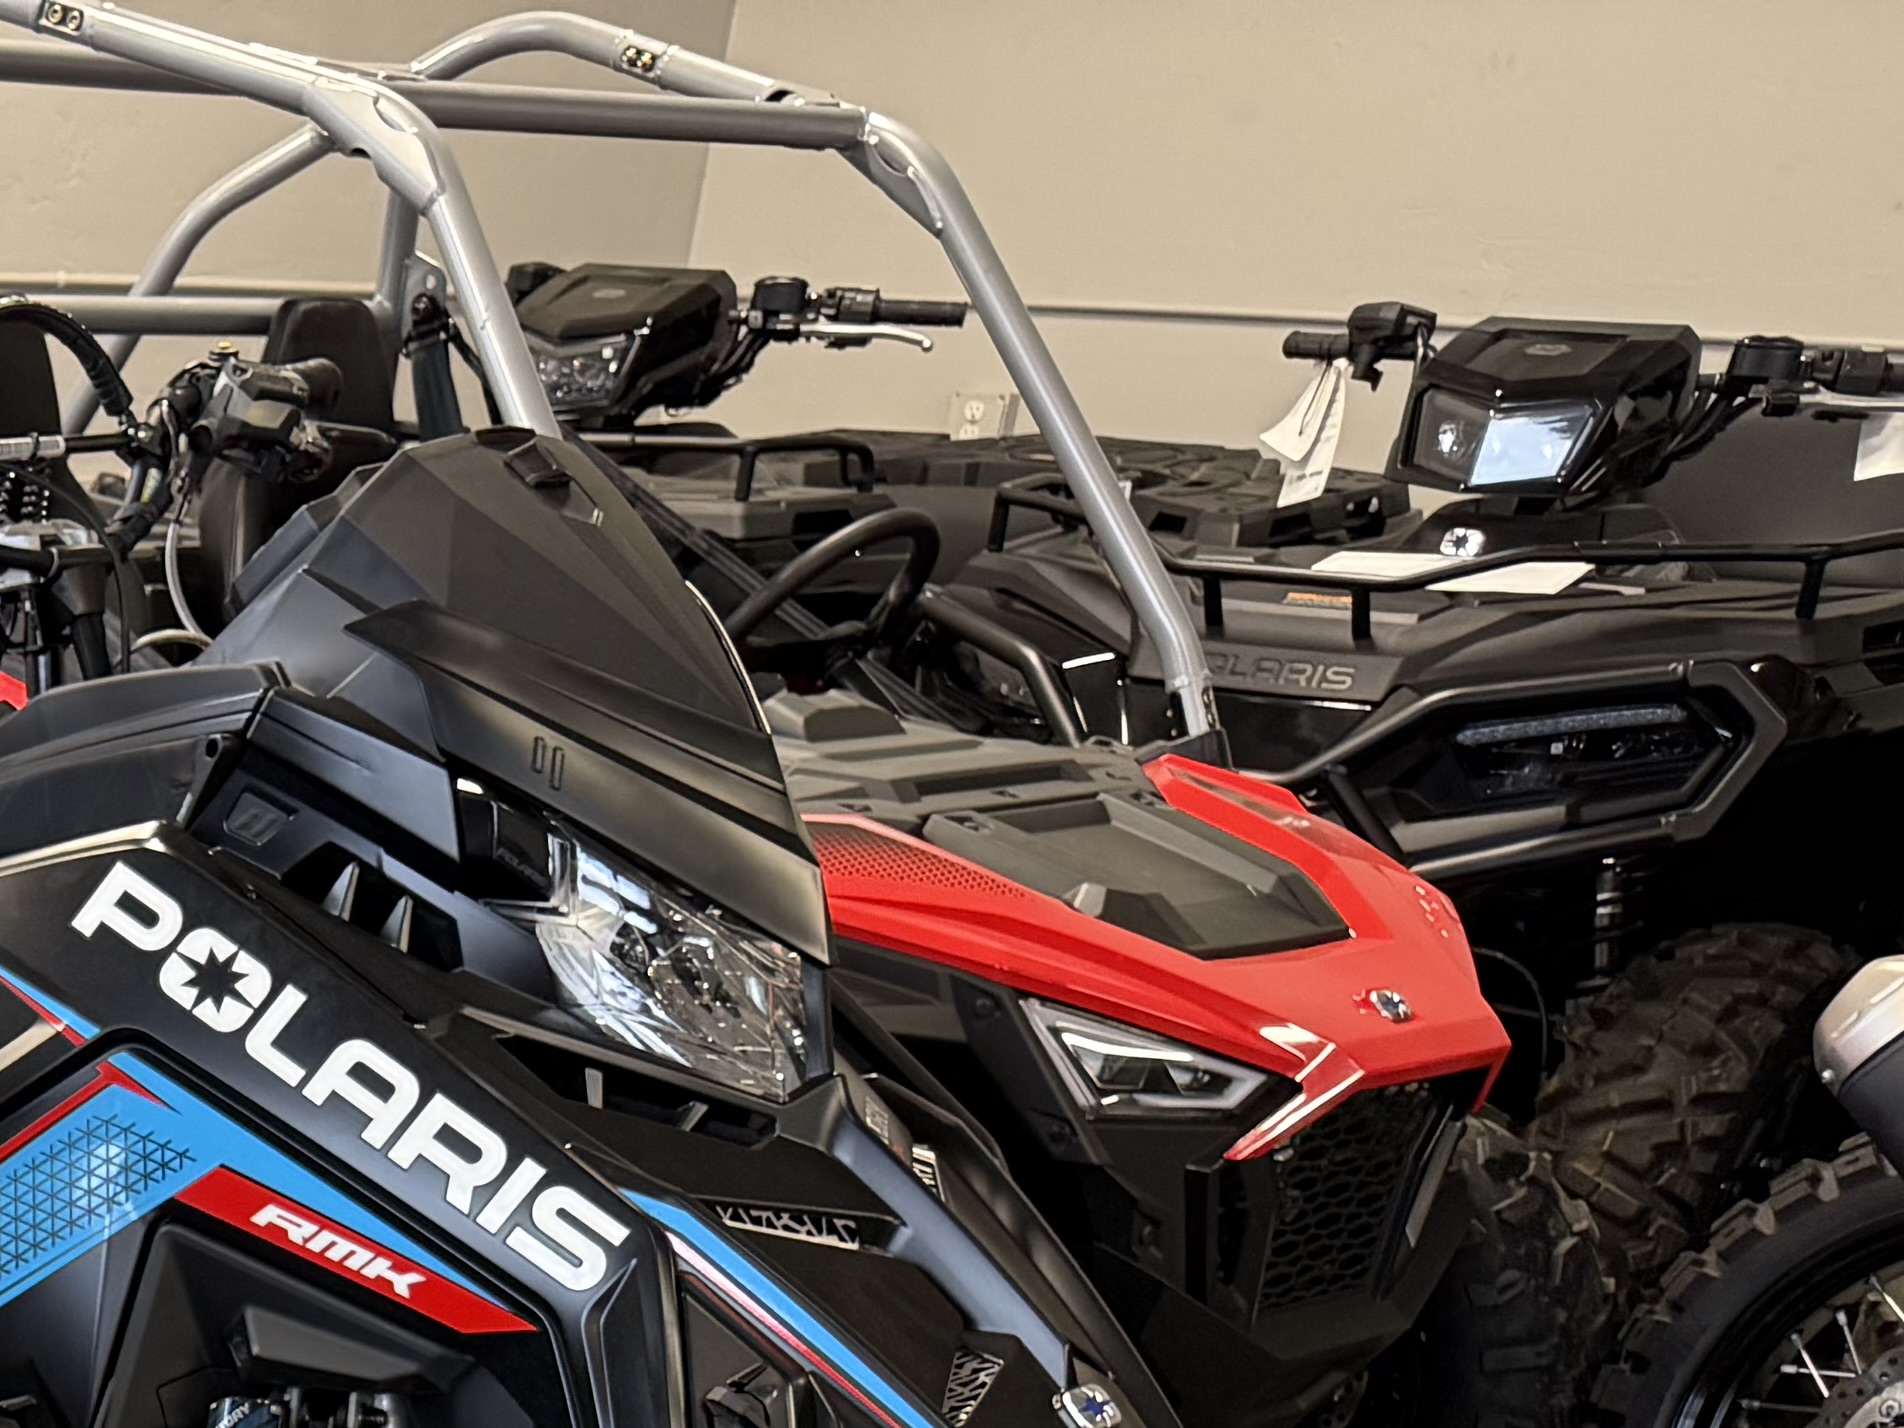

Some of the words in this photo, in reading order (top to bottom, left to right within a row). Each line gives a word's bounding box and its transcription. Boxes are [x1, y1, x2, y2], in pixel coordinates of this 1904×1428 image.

[1204, 651, 1356, 691] OLARIS
[70, 860, 632, 1292] POLARIS
[249, 1203, 427, 1300] RMK
